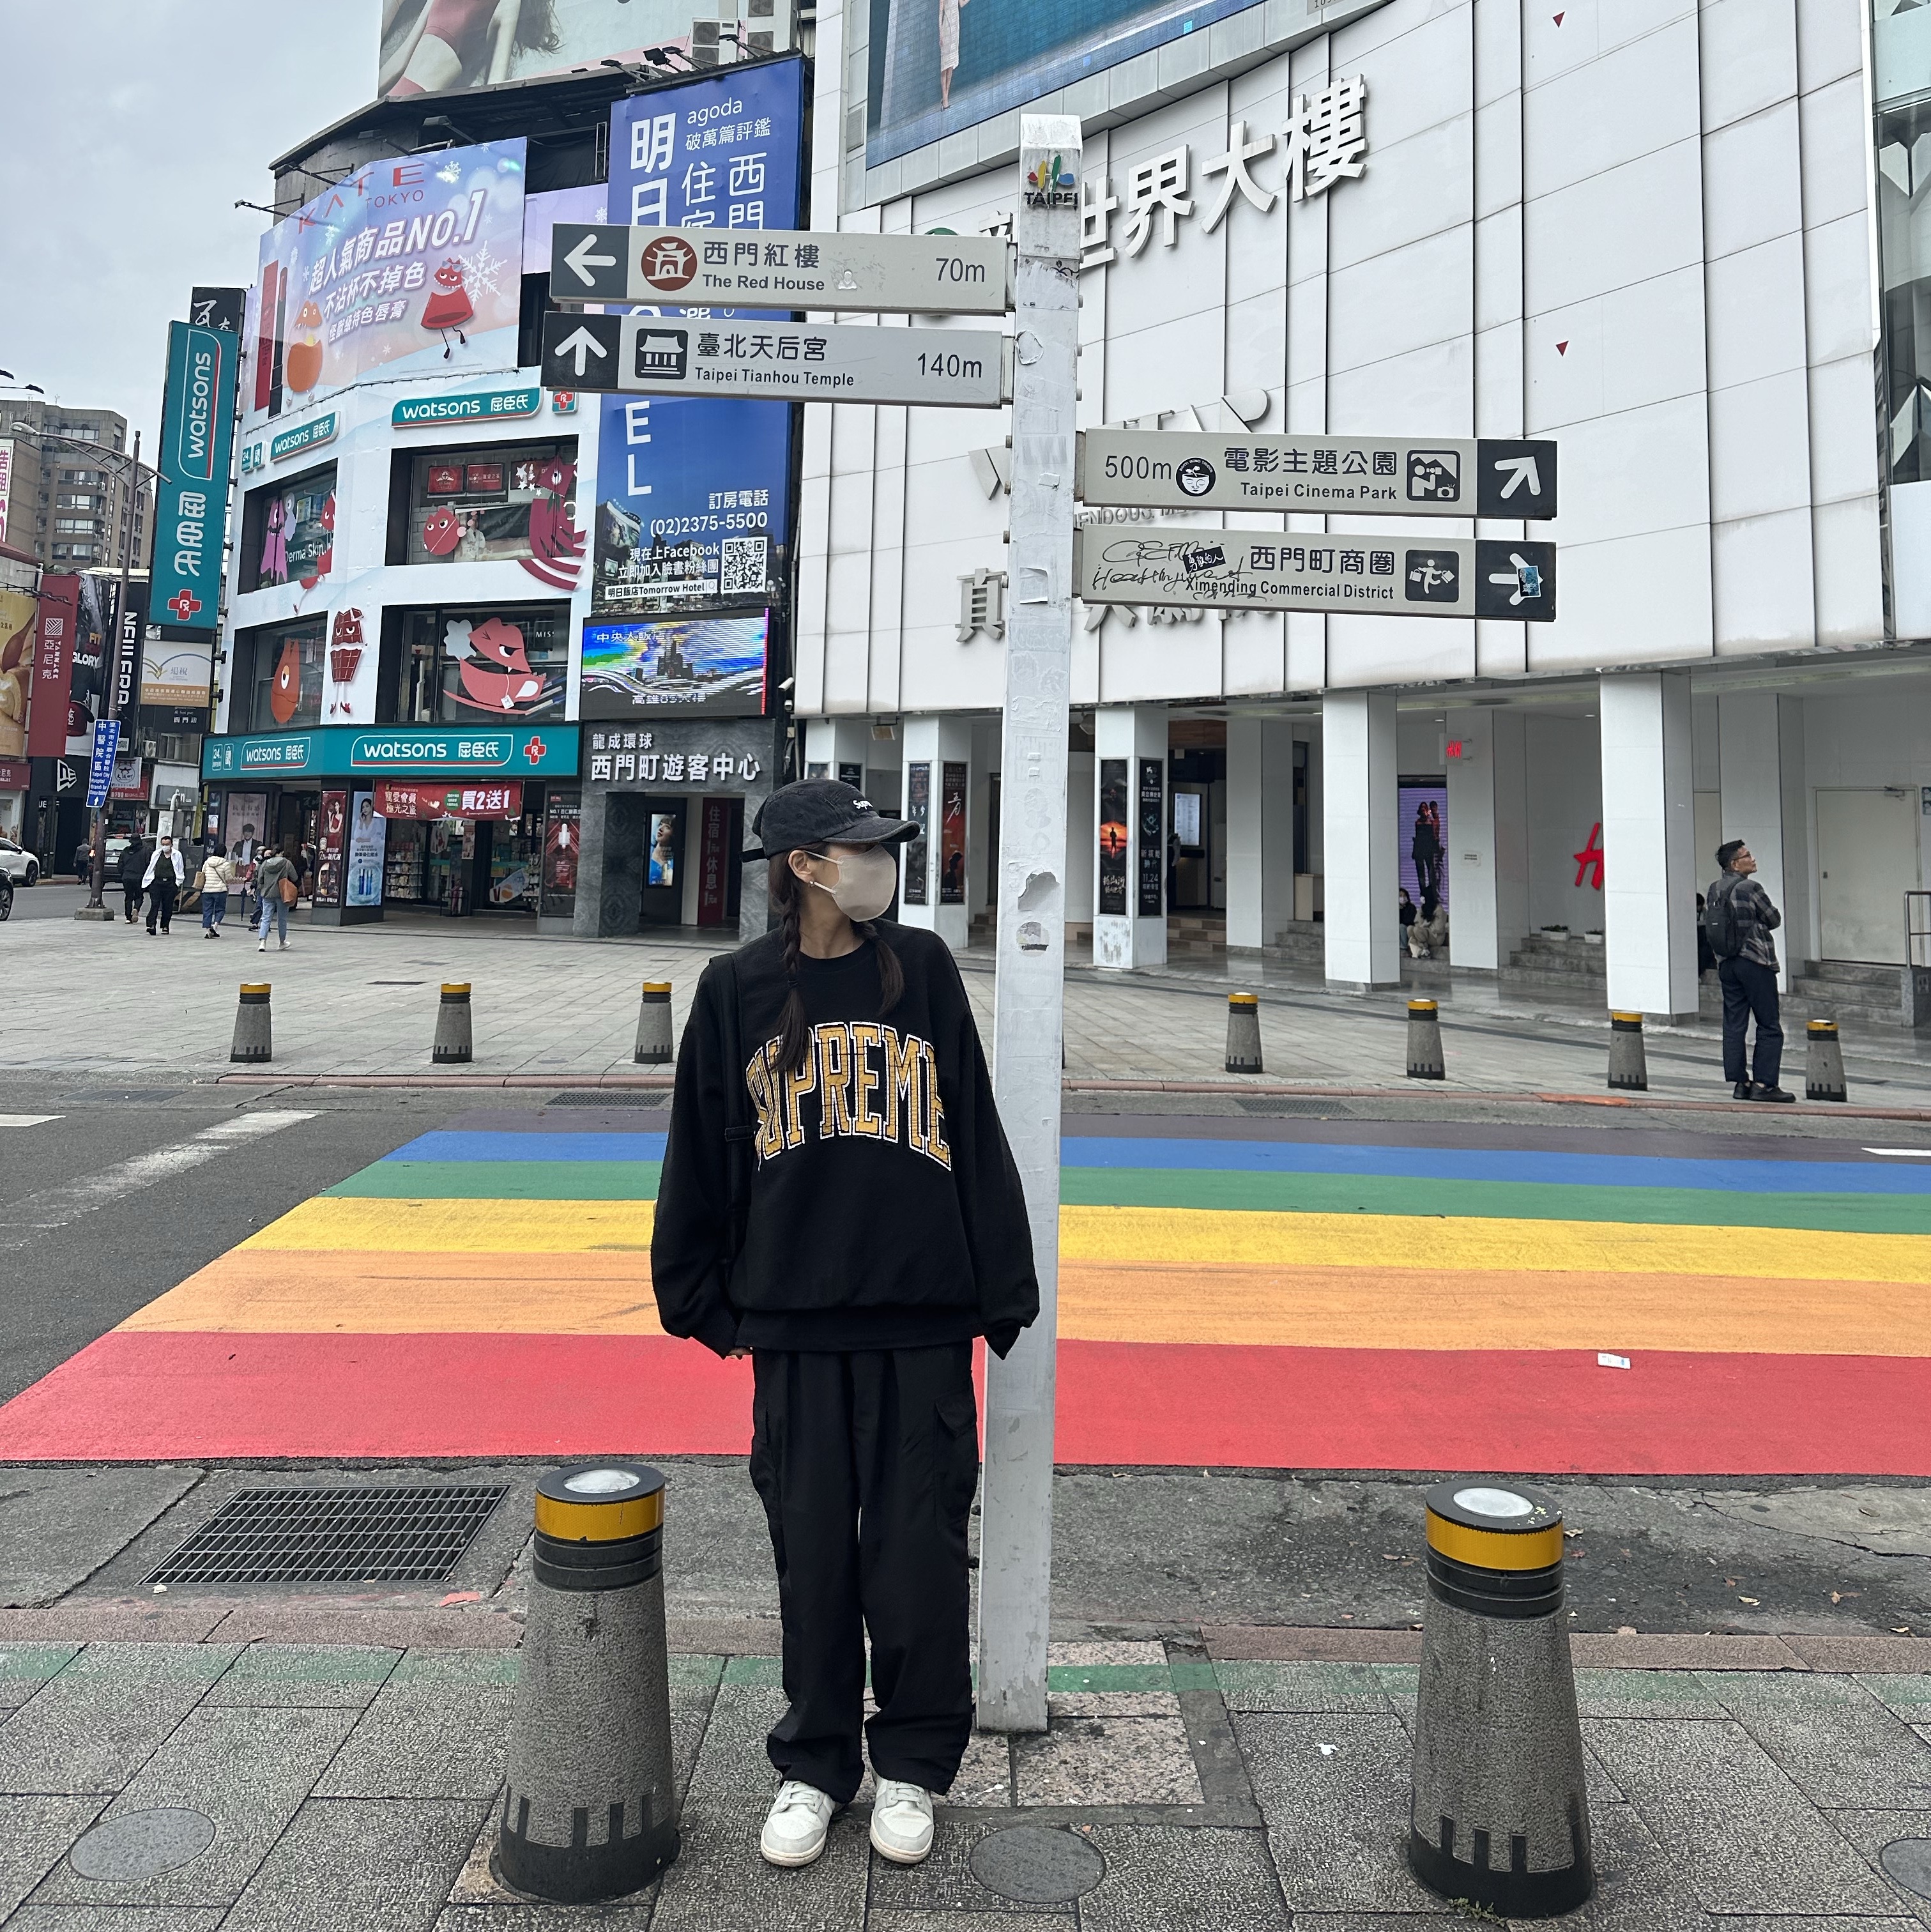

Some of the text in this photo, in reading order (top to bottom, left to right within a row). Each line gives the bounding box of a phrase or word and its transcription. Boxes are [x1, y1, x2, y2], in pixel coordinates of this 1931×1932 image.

[687, 97, 742, 126] agoda
[685, 117, 771, 151] 破萬篇評鑑
[298, 164, 425, 234] KATE
[365, 190, 424, 209] TOKYO
[1024, 192, 1078, 206] TAIPEI
[309, 191, 484, 296] 超人氣商品NO.1
[704, 241, 820, 269] 西門紅樓
[936, 257, 986, 282] 70m
[324, 261, 426, 319] 不沾杯不掉色
[703, 274, 825, 291] The Red House
[698, 332, 827, 361] 臺北天后宮
[695, 367, 854, 388] Taipei Tianhou Temple
[918, 353, 982, 378] 140m
[188, 351, 211, 459] watsons
[402, 394, 528, 419] watsons 屈臣氏
[275, 429, 309, 454] watsons
[1105, 456, 1172, 480] 500m
[1224, 447, 1397, 476] 電影主題公園
[709, 489, 768, 510] 訂房電話
[1240, 482, 1397, 500] Taipei Cinema Park
[174, 491, 206, 576] 屈臣氏
[650, 511, 768, 537] (02)2375-5500
[630, 542, 719, 562] 現在上Facebook
[1251, 546, 1394, 575] 西門町商圈
[618, 558, 719, 579] 立即加入臉書粉絲團
[682, 582, 705, 593] Hotel
[1186, 579, 1394, 599] Ximending Commercial District
[42, 640, 55, 680] 亞尼克
[247, 746, 282, 762] watsons
[364, 742, 500, 758] watsons 屈臣氏
[592, 733, 653, 750] 龍成環球
[591, 753, 761, 781] 西門町遊客中心
[462, 790, 510, 811] 買2送1
